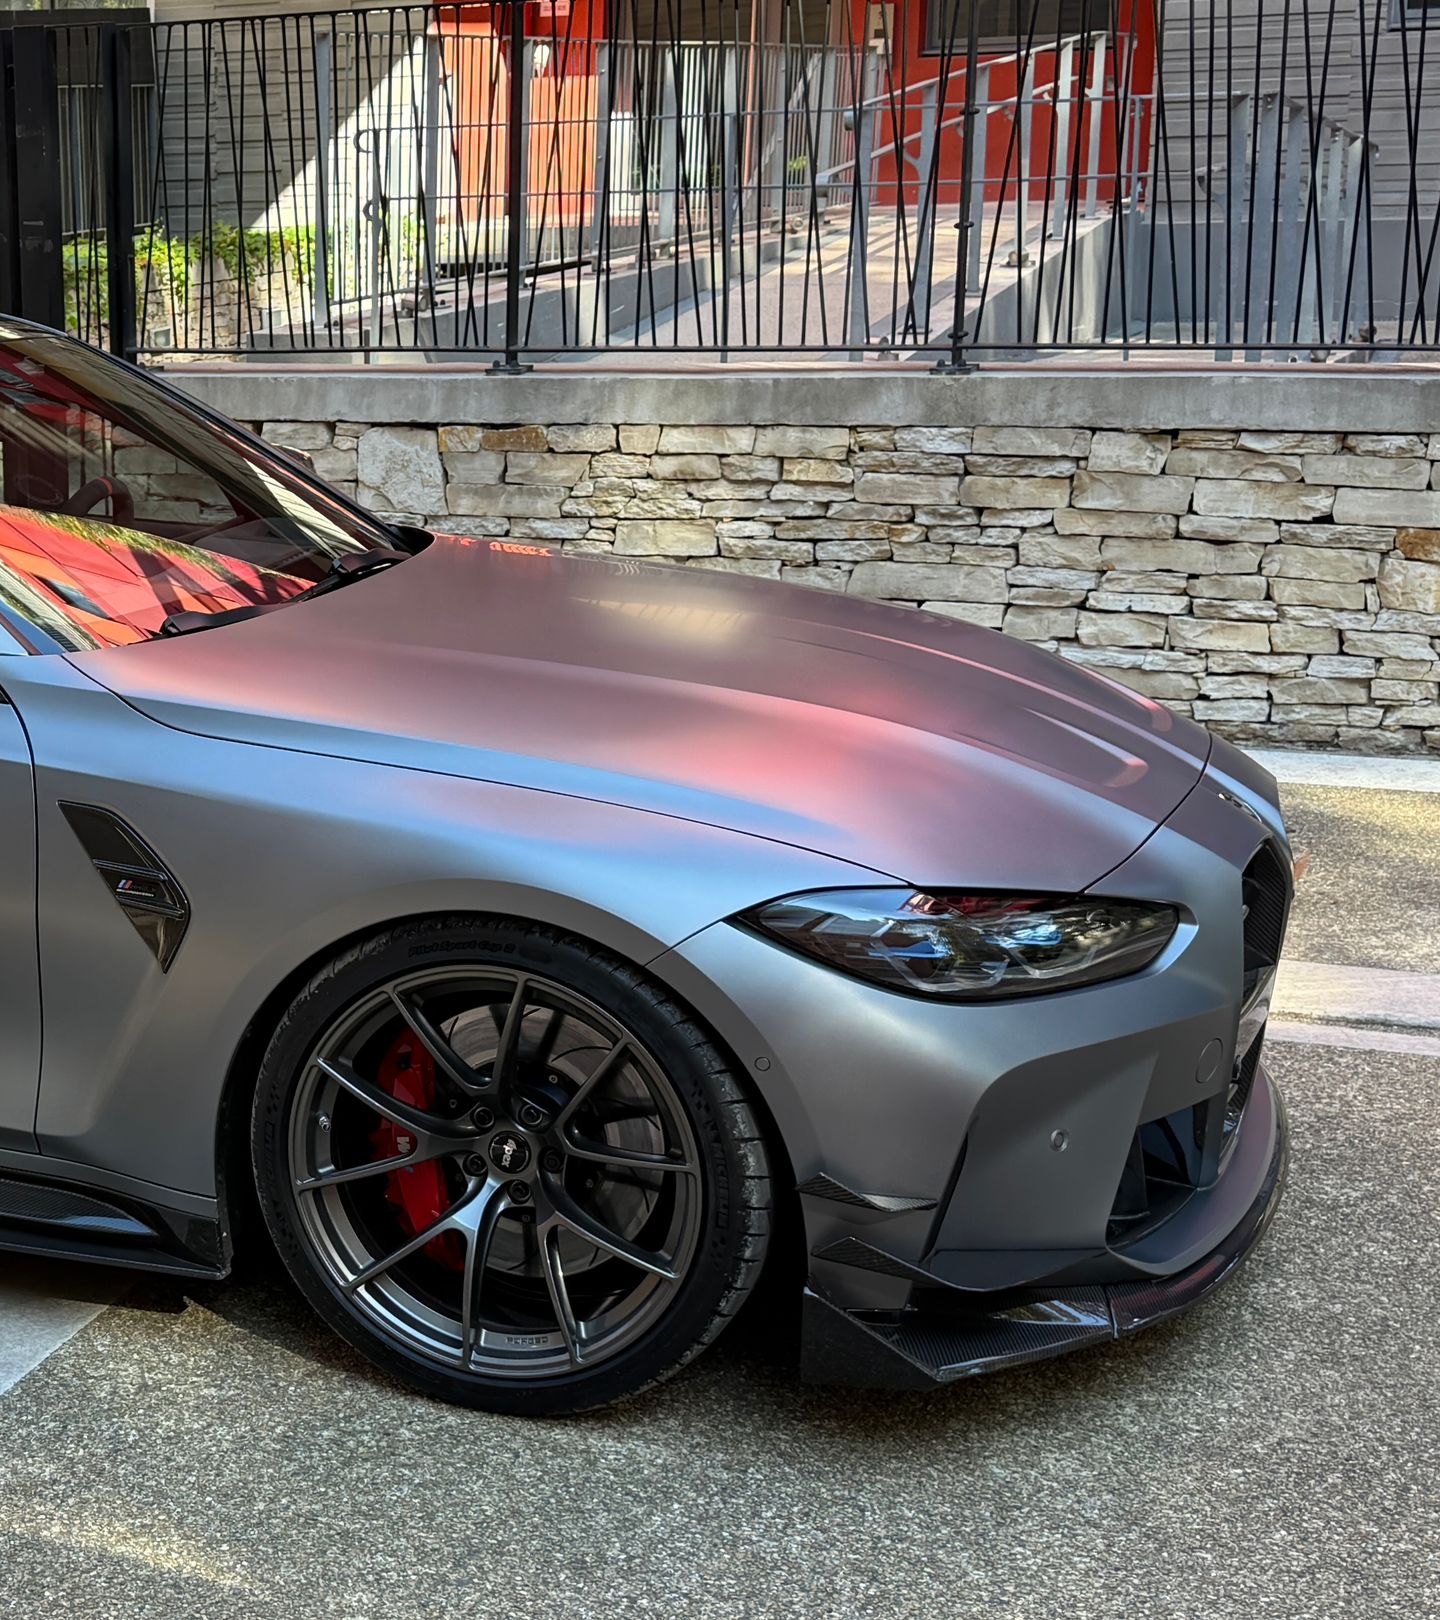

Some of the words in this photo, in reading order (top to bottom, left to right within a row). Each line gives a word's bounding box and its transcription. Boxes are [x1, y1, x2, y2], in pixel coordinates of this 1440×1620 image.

[438, 940, 475, 951] Sport
[478, 940, 501, 951] Cup
[503, 942, 515, 953] 2
